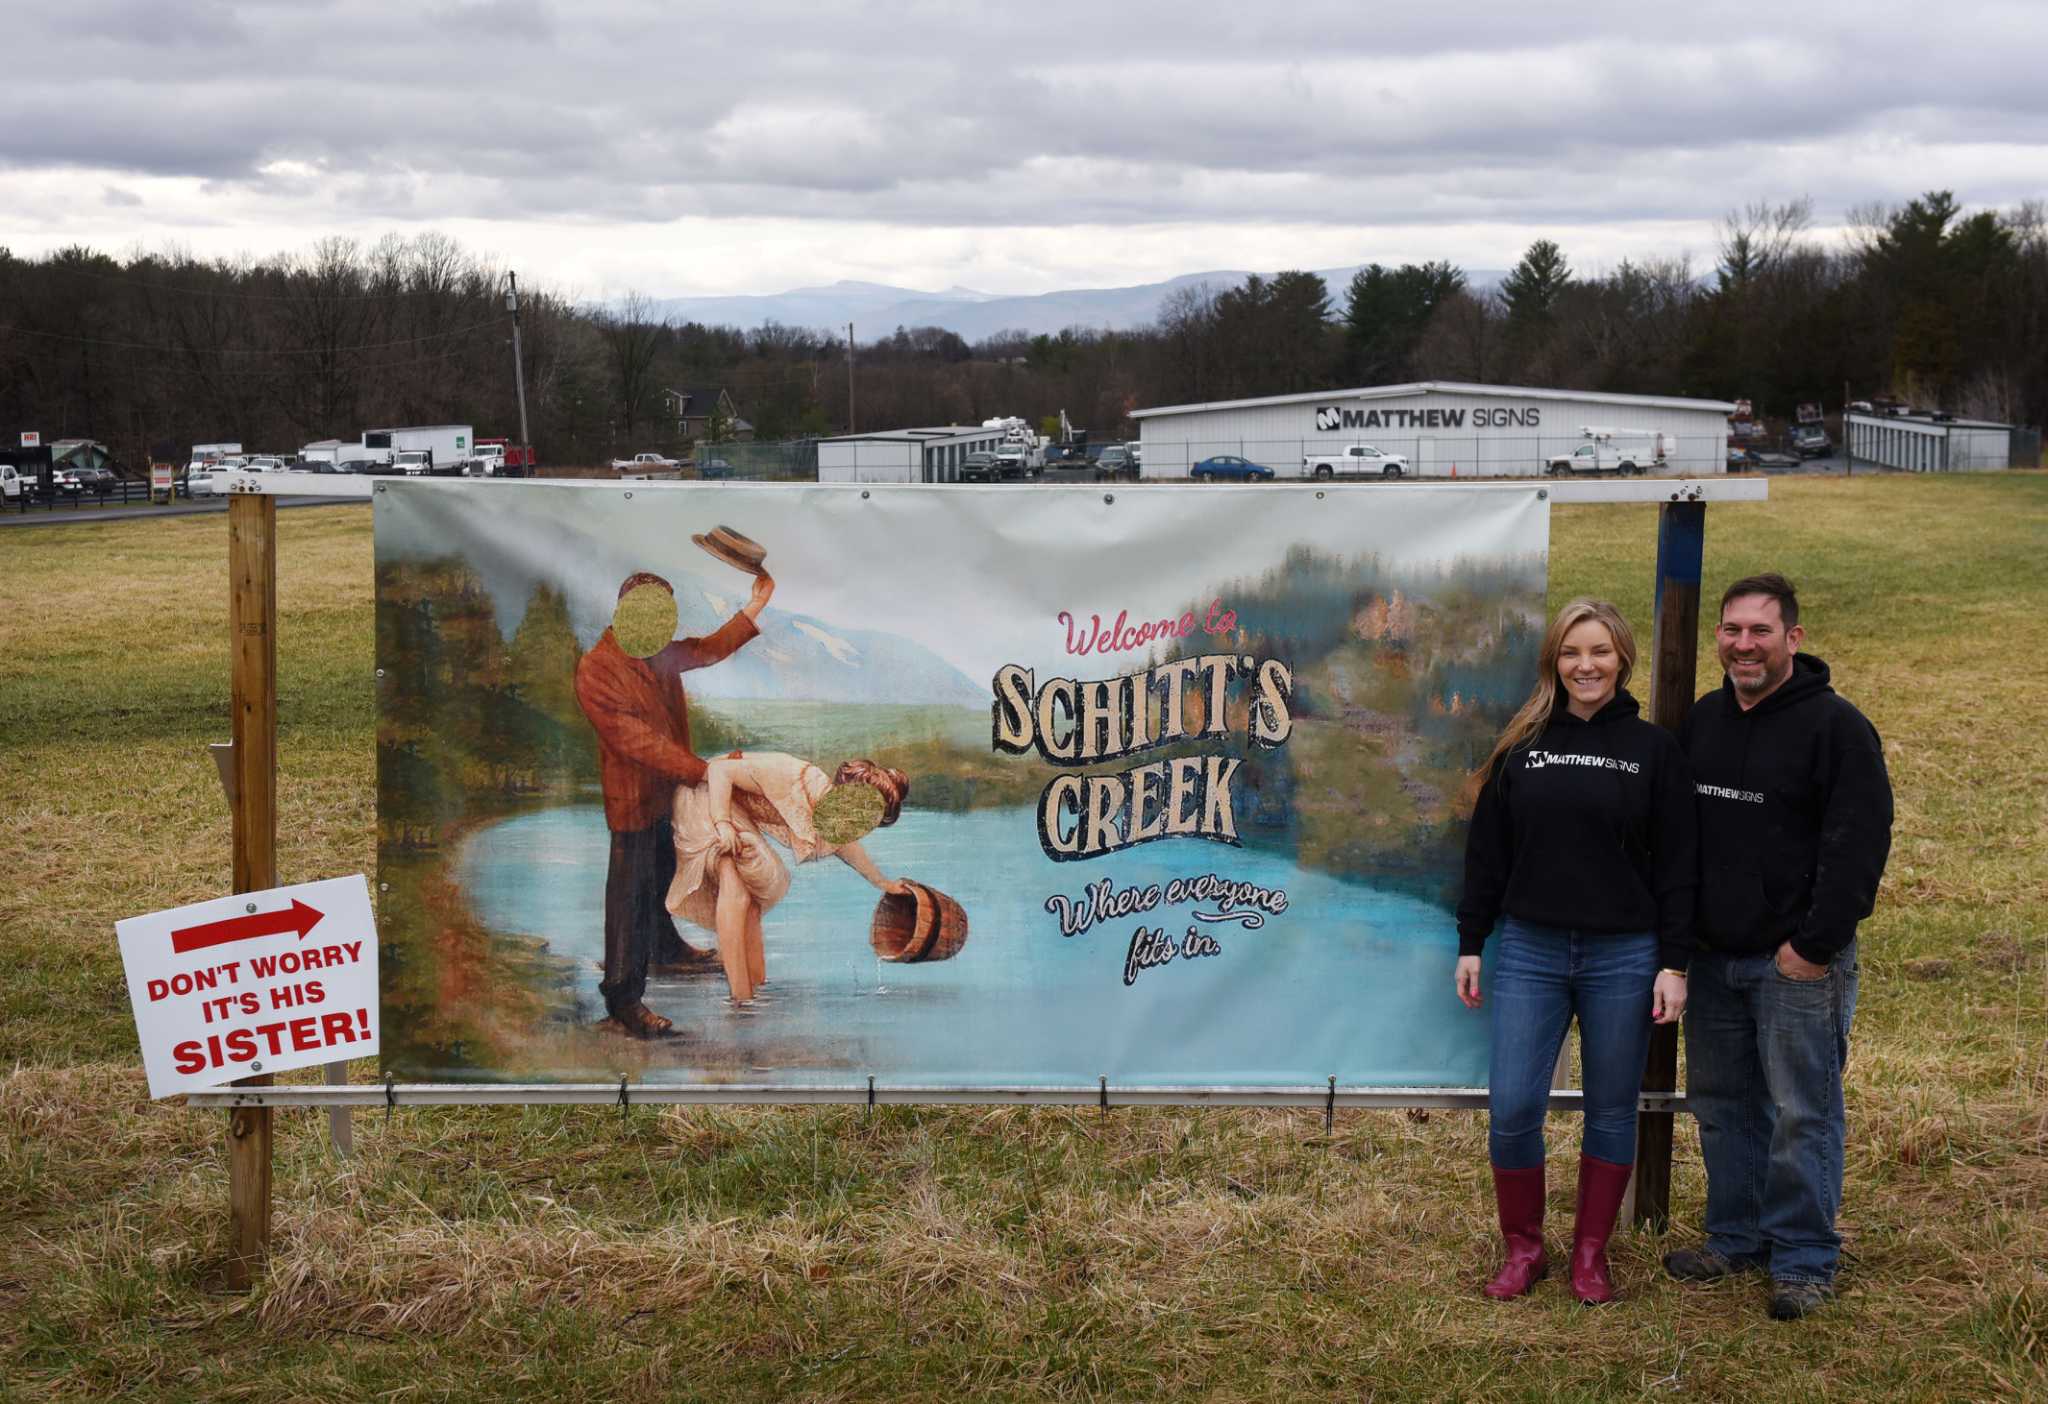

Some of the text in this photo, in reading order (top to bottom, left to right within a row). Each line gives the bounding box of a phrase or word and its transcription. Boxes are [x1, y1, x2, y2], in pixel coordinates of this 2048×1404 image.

[1343, 409, 1466, 428] MATTHEW
[1472, 408, 1540, 427] SIGNS
[1057, 597, 1237, 656] Welcome to
[992, 653, 1294, 766] SCHITT'S
[1036, 754, 1246, 863] CREEK
[1045, 873, 1289, 937] Where everyone
[147, 941, 362, 1002] DON'T WORRY
[1123, 925, 1222, 986] fits in.
[202, 981, 326, 1024] IT'S HIS
[172, 1008, 372, 1075] SISTER!
